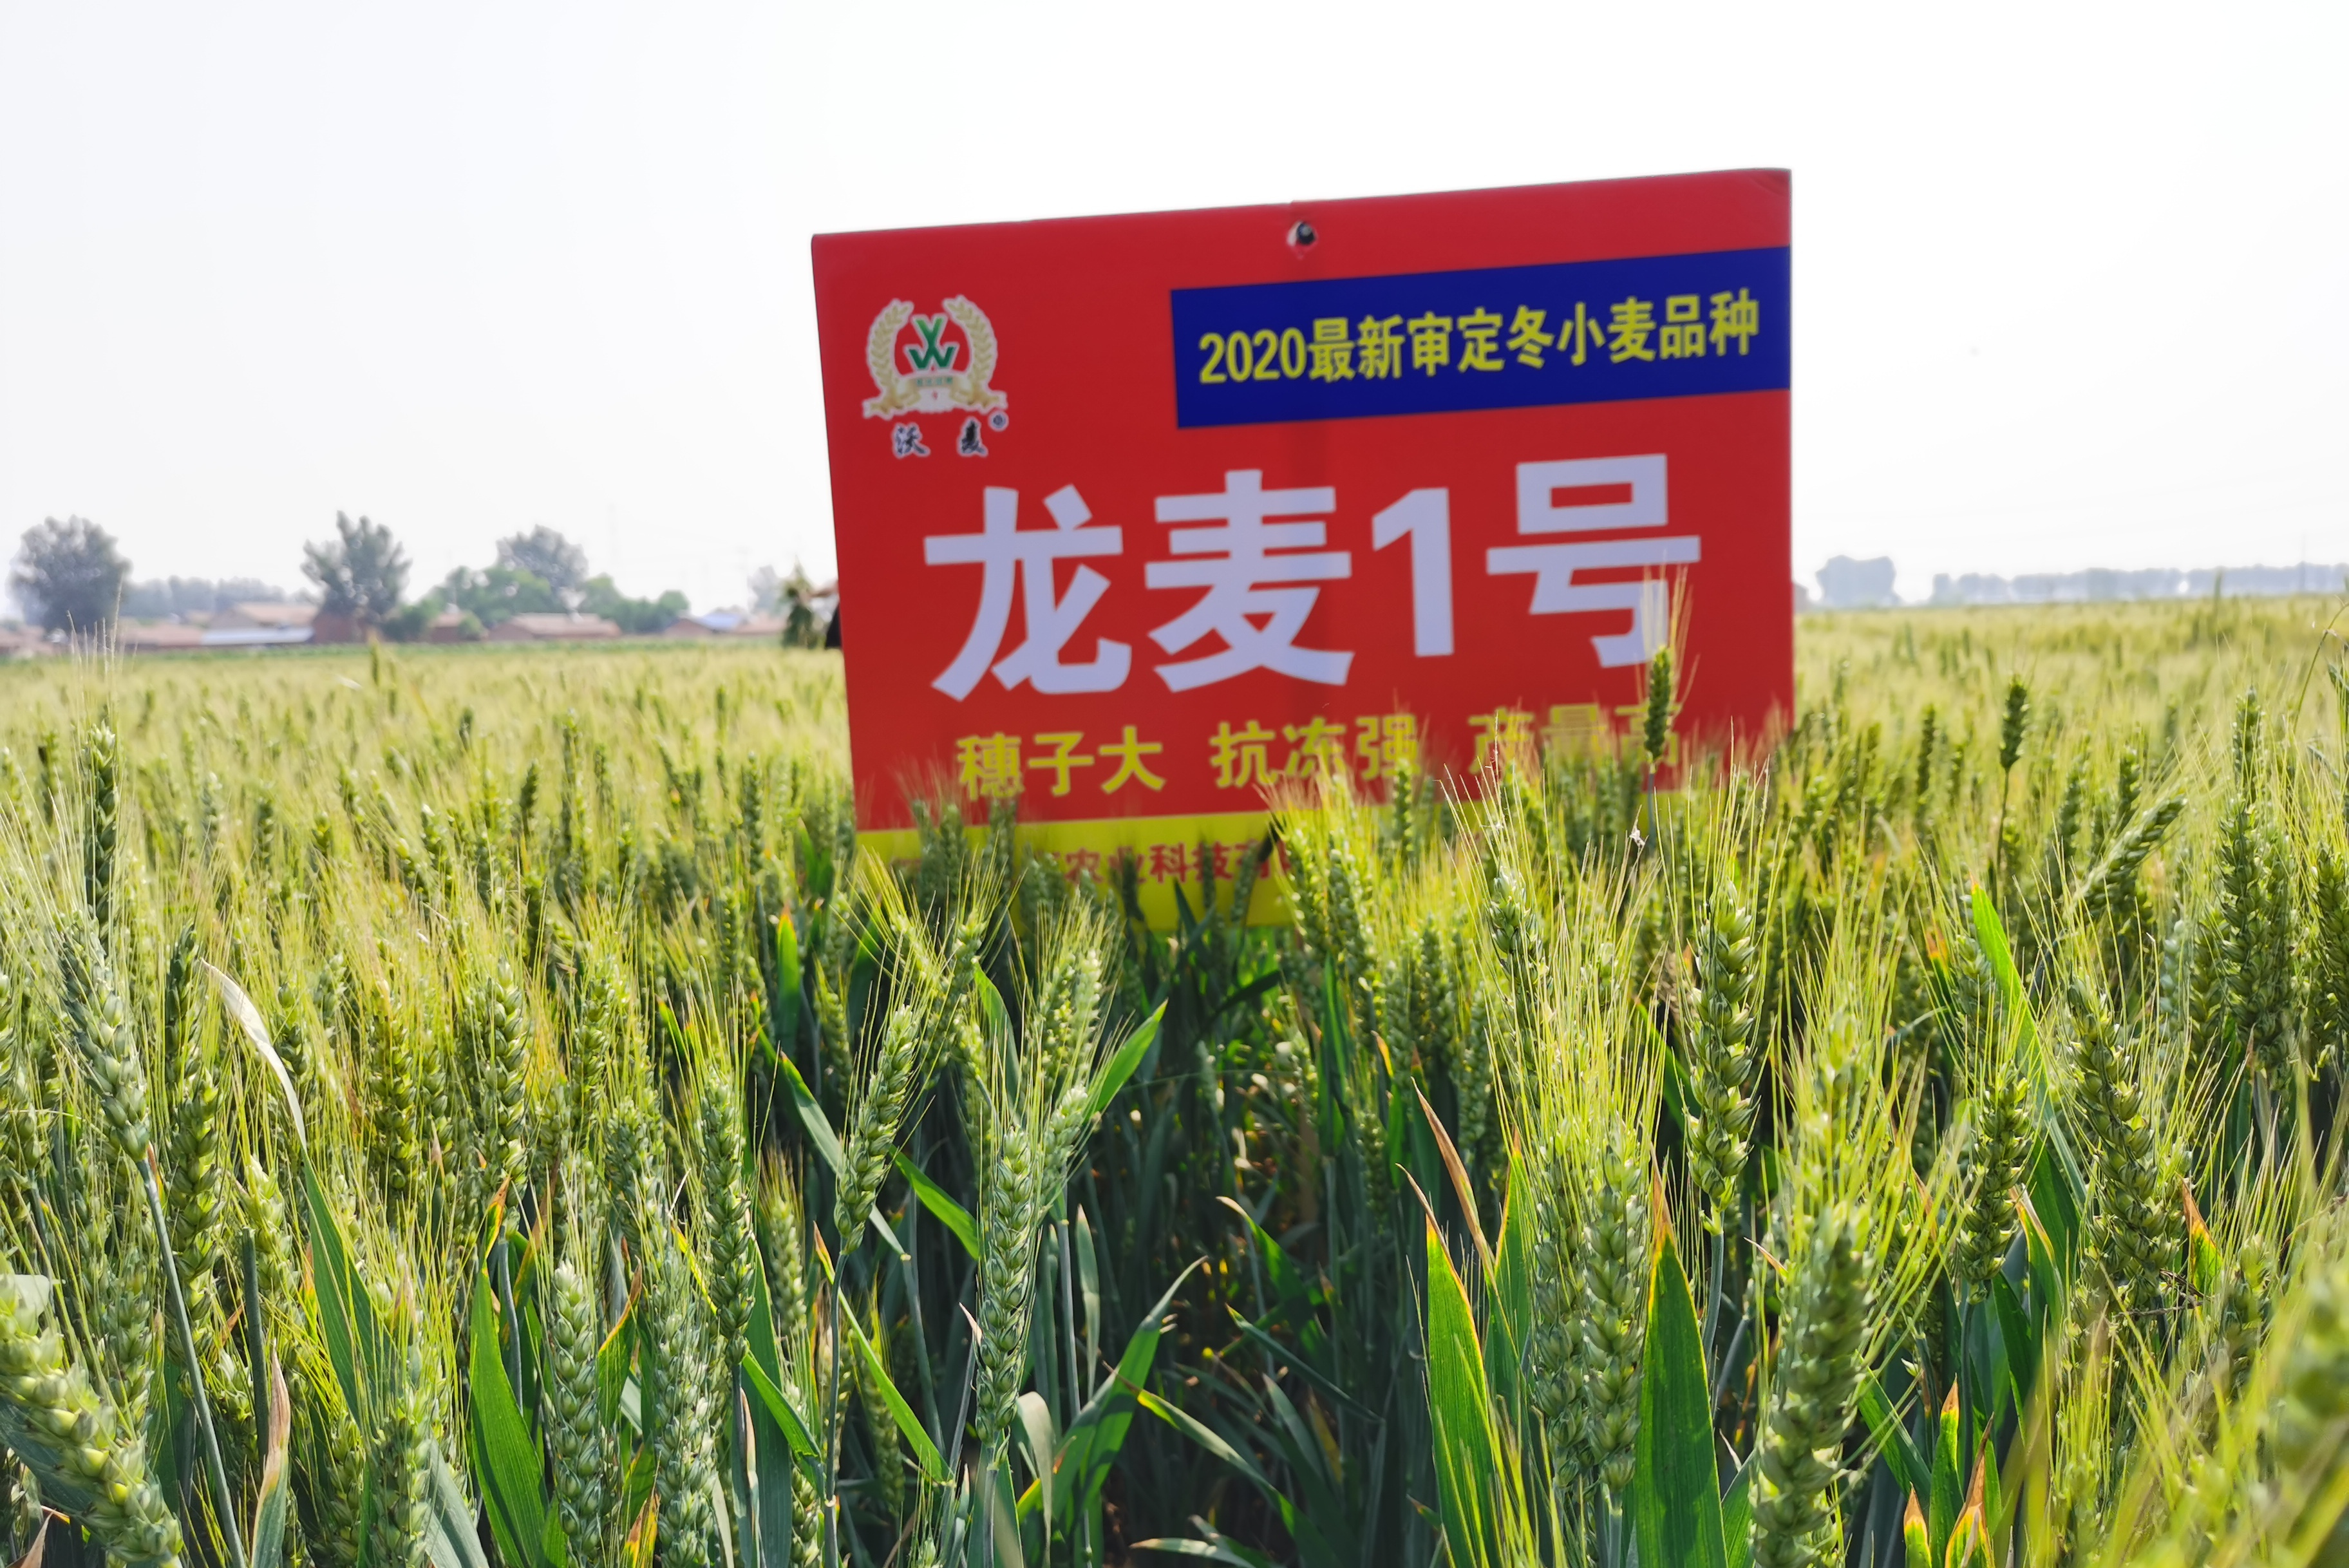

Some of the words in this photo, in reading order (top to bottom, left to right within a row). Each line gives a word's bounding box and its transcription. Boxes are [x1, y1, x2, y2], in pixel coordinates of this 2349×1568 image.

[1199, 288, 1759, 384] 2020最新审定冬小麦品种
[923, 453, 1701, 702] 龙麦1号
[1209, 716, 1421, 790] 抗冻强
